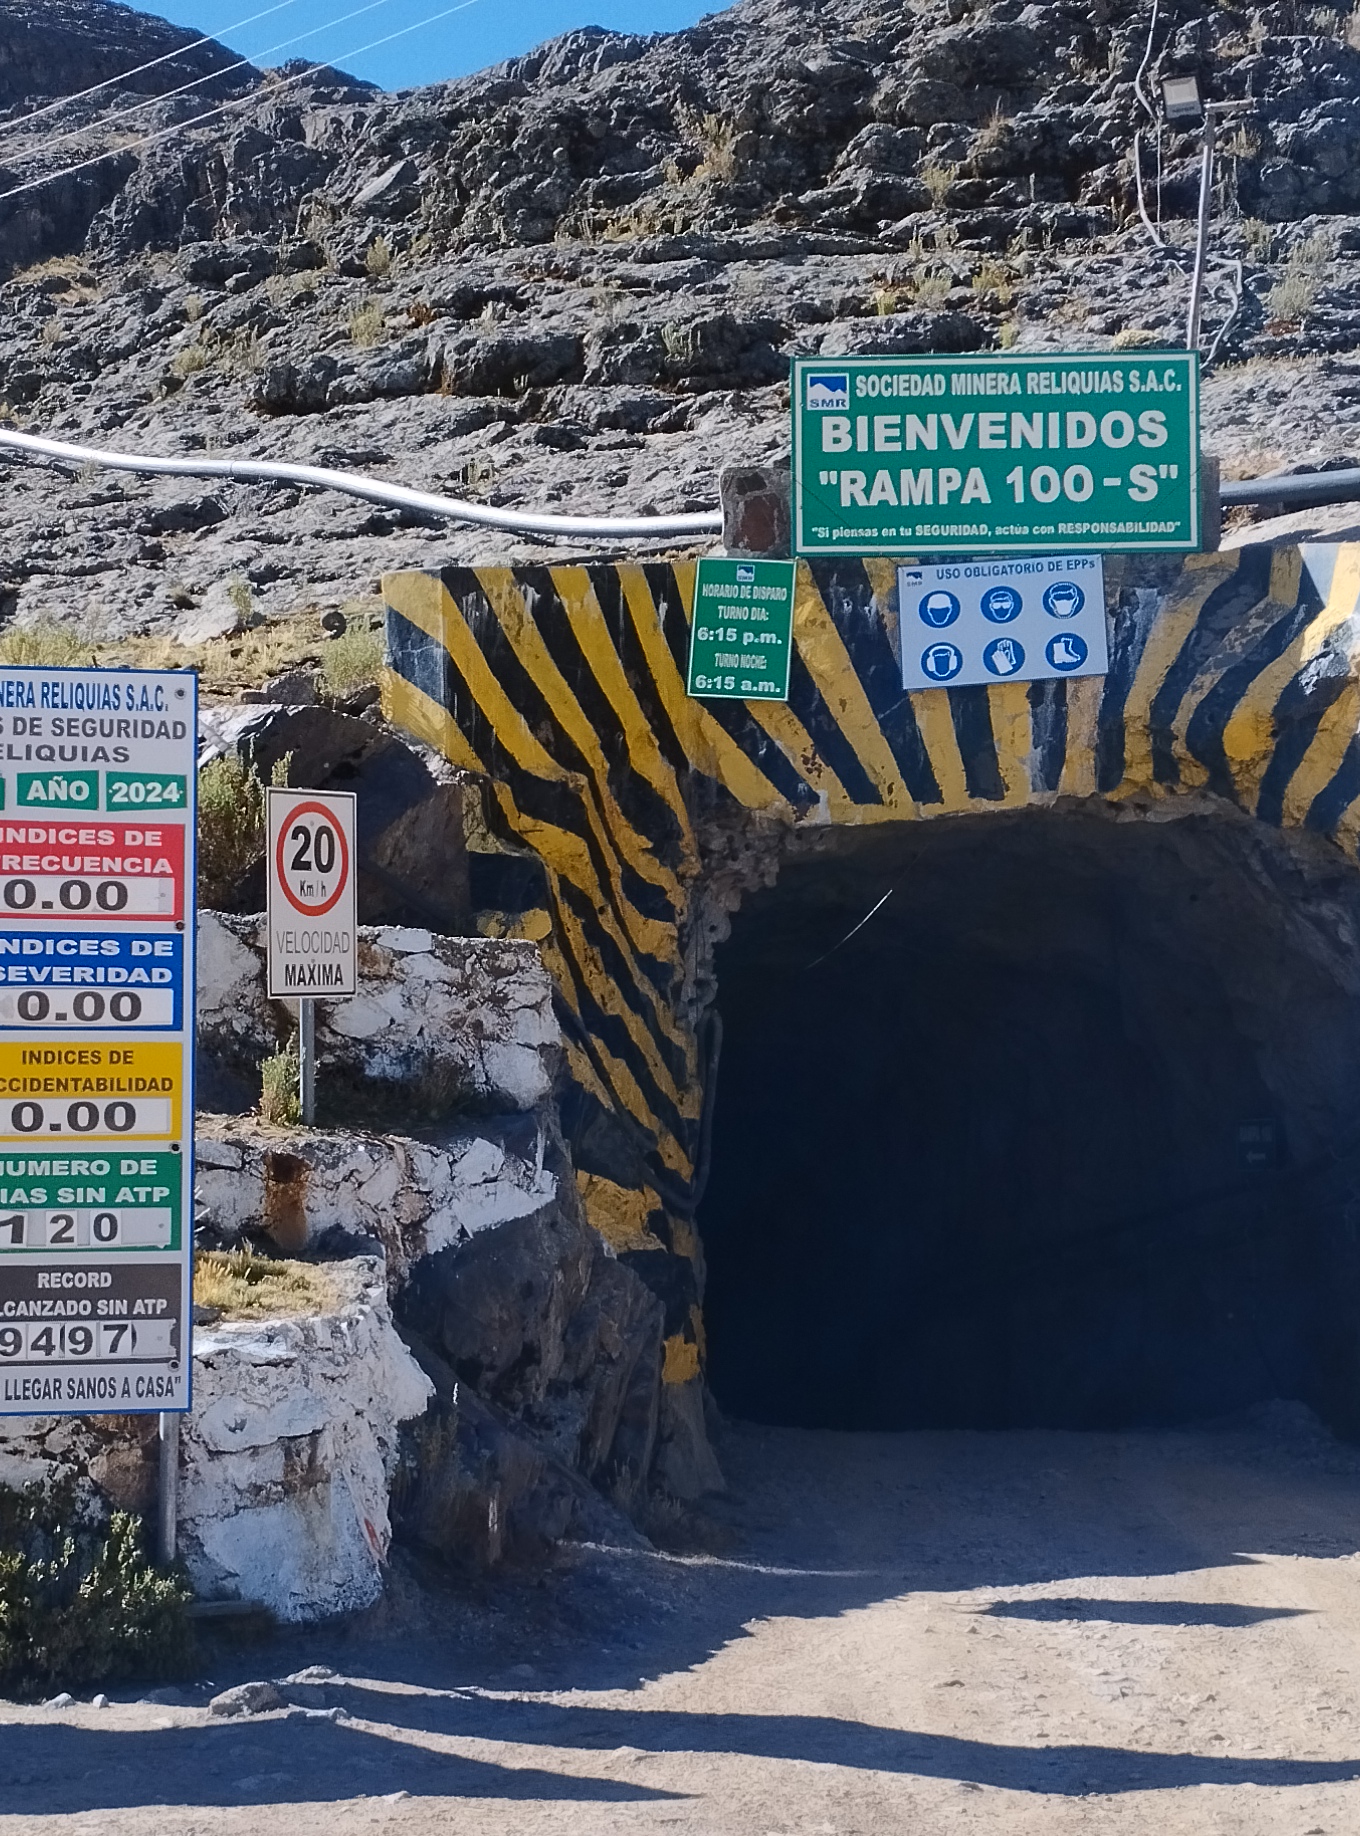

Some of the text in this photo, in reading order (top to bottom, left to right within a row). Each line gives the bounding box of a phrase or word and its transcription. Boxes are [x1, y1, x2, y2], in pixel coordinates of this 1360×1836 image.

[855, 369, 1182, 398] SOCIEDAD MINERA RELIQUIAS S.A.C.
[810, 399, 847, 408] SMR
[822, 411, 1168, 453] BIENVENIDOS
[818, 465, 991, 507] "RAMPA
[1005, 465, 1094, 504] 100
[833, 527, 878, 540] piensas
[882, 528, 896, 537] en
[900, 526, 911, 536] tu
[915, 524, 991, 537] SEGURIDAD,
[1033, 525, 1054, 534] con
[1058, 521, 1181, 534] RESPONSABILIDAD"
[937, 559, 1095, 580] USO OBLIGATORIO DE EPPs
[702, 583, 787, 601] HORARIO DE DISPARO
[718, 605, 769, 621] TURNO DIA:
[697, 627, 782, 645] 6:15 p.m.
[714, 653, 739, 668] TURNO
[695, 675, 780, 692] 6:15 a.m.
[40, 681, 121, 711] RELIQUIAS
[125, 684, 169, 712] S.A.C.
[13, 716, 44, 736] DE
[51, 718, 186, 740] SEGURIDAD
[26, 776, 89, 801] AÑO
[110, 782, 181, 803] 2024
[124, 830, 162, 847] DE
[290, 825, 335, 873] 20
[3, 879, 129, 910] 0.00
[131, 941, 173, 956] DE
[276, 930, 350, 954] VELOCIDAD
[285, 963, 344, 986] MAXIMA
[17, 990, 142, 1021] 0.00
[22, 1050, 134, 1065] INDICES DE
[11, 1101, 137, 1132] 0.00
[120, 1159, 158, 1175] DE
[57, 1188, 105, 1203] SIN
[115, 1187, 170, 1202] ATP
[37, 1272, 112, 1288] RECORD
[97, 1300, 128, 1315] SIN
[133, 1299, 167, 1315] ATP
[5, 1378, 62, 1401] LLEGAR
[66, 1377, 117, 1399] SANOS
[121, 1377, 131, 1397] A
[135, 1376, 181, 1398] CASA"
